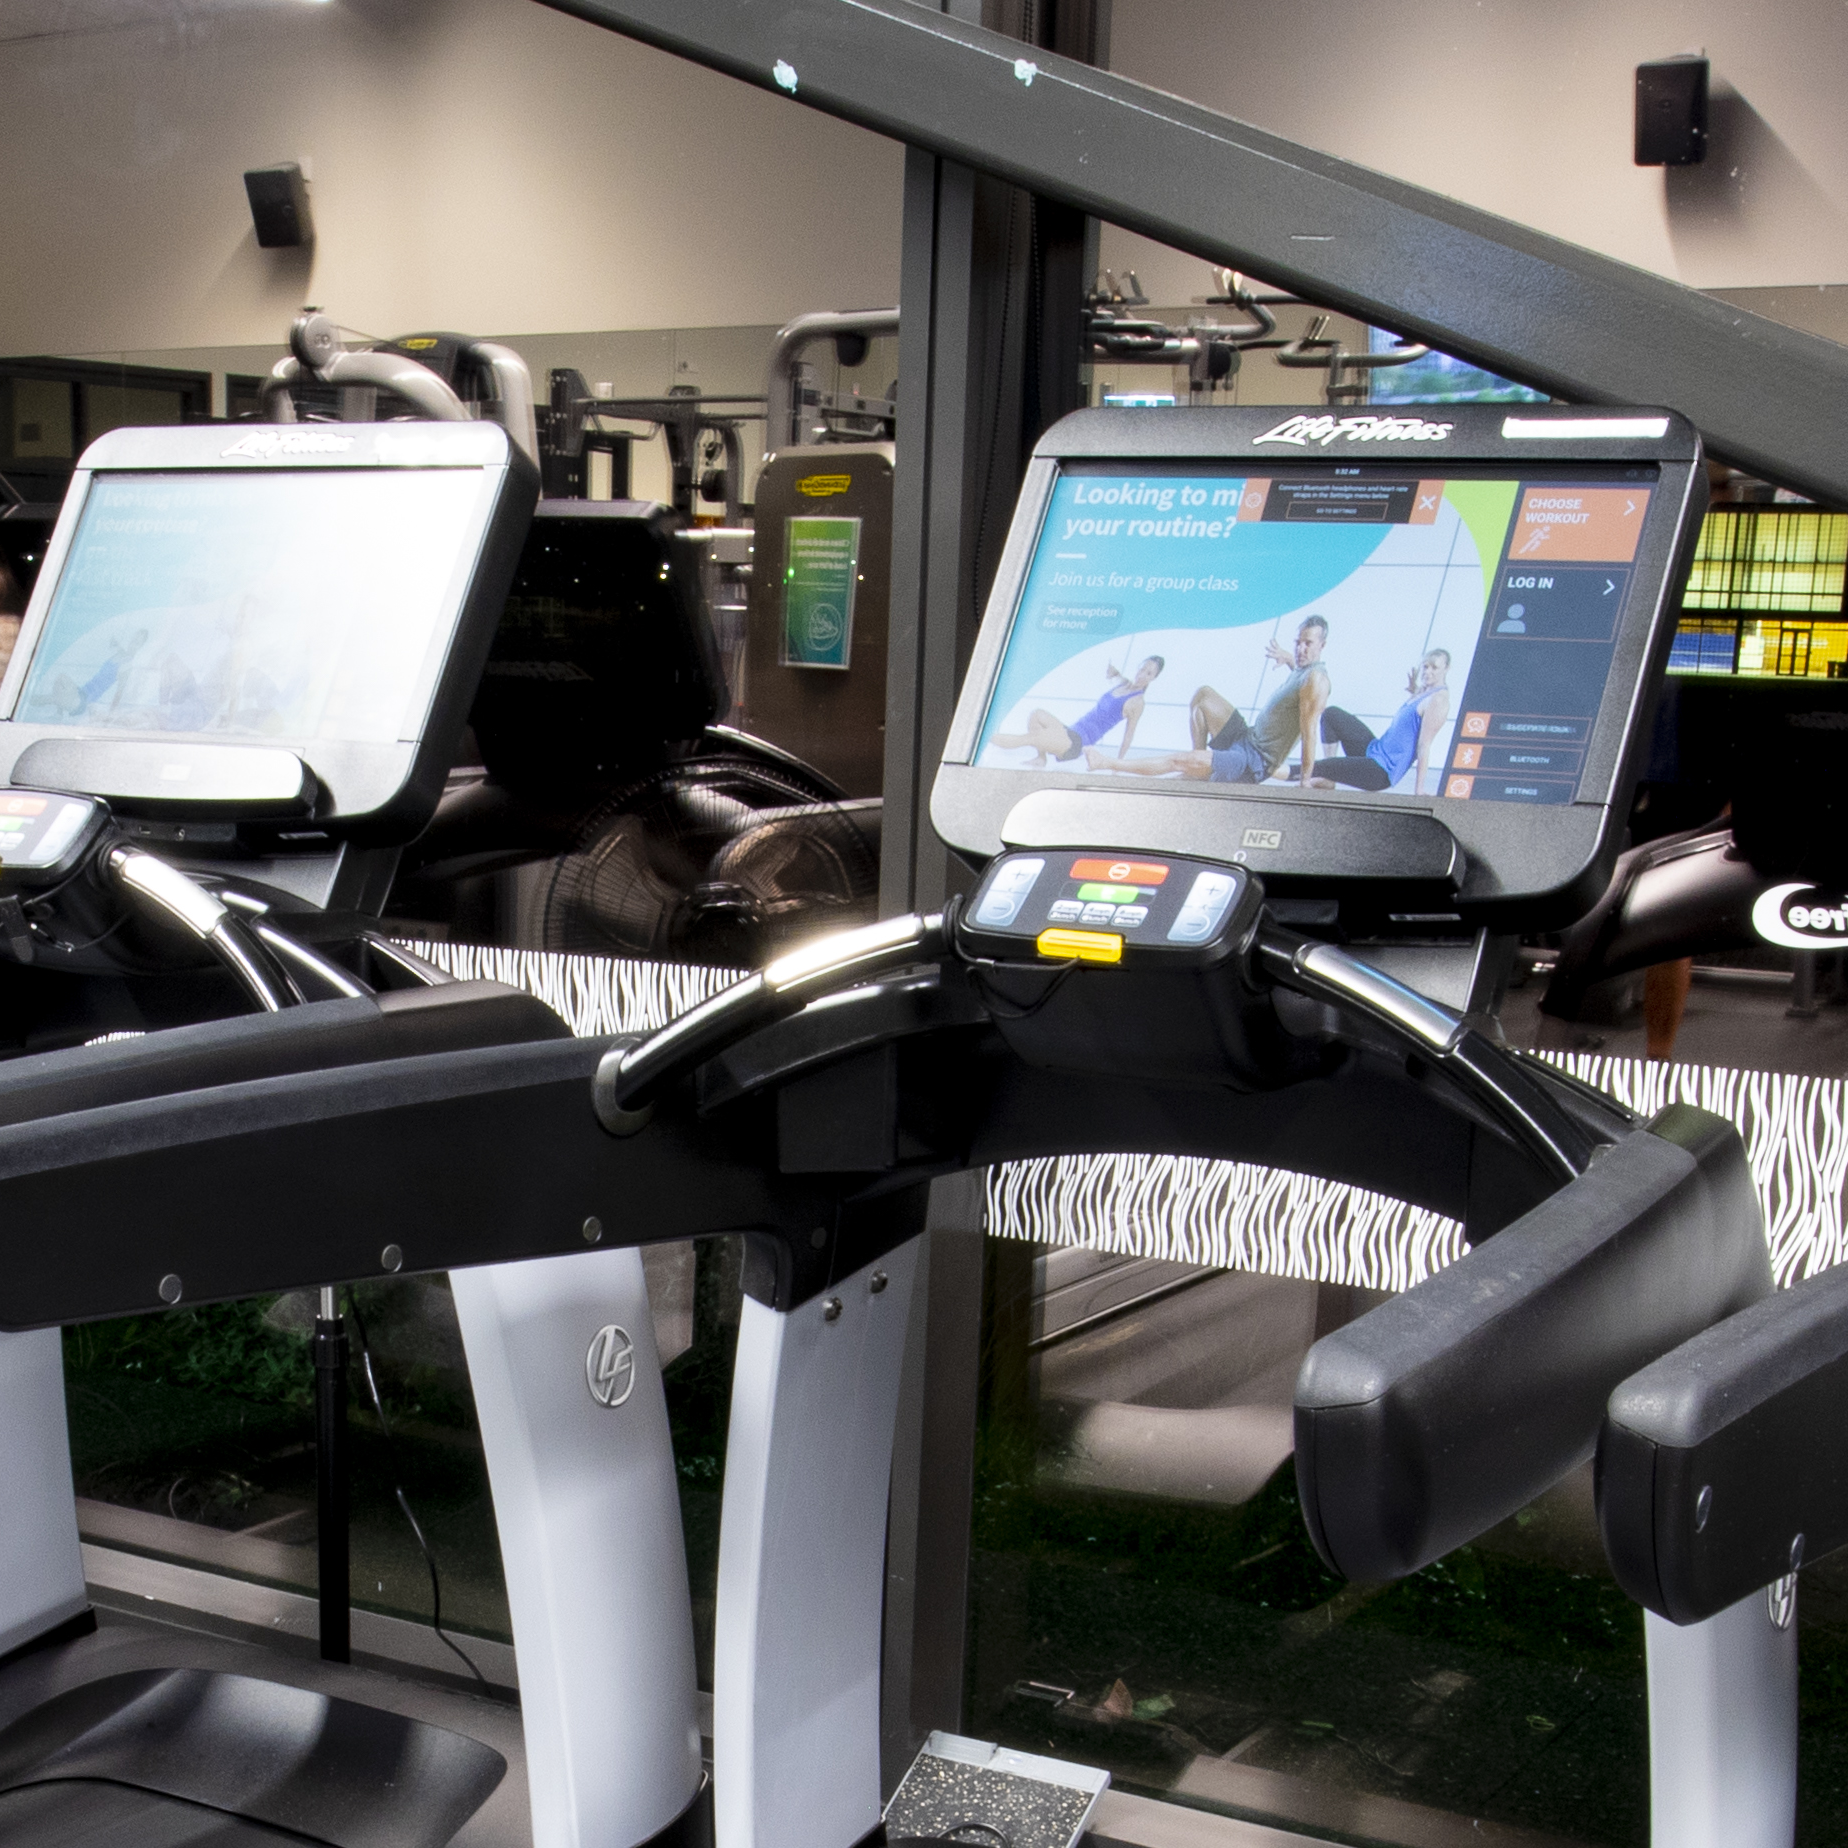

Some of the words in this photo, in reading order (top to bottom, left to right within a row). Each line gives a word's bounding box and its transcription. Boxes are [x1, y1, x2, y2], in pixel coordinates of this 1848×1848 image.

[1252, 415, 1334, 446] Life
[1320, 416, 1454, 446] Fitness
[1073, 483, 1176, 512] Looking
[1181, 485, 1204, 507] to
[1211, 484, 1246, 507] mi
[1528, 498, 1583, 510] CHOOSE
[1525, 512, 1590, 524] WORKOUT
[1062, 518, 1124, 541] your
[1126, 515, 1237, 539] routine?
[1048, 571, 1083, 587] Join
[1086, 574, 1104, 587] us
[1107, 572, 1130, 588] for
[1133, 577, 1143, 588] a
[1145, 576, 1195, 593] group
[1198, 575, 1239, 591] class
[1507, 577, 1536, 589] LOG
[1537, 577, 1554, 589] IN
[1046, 604, 1066, 617] See
[1067, 606, 1117, 620] reception
[1043, 618, 1059, 629] for
[1059, 620, 1088, 630] more
[1509, 755, 1550, 764] BLUETOOTH
[1504, 786, 1539, 796] SETTINGS
[1246, 832, 1279, 846] NFC
